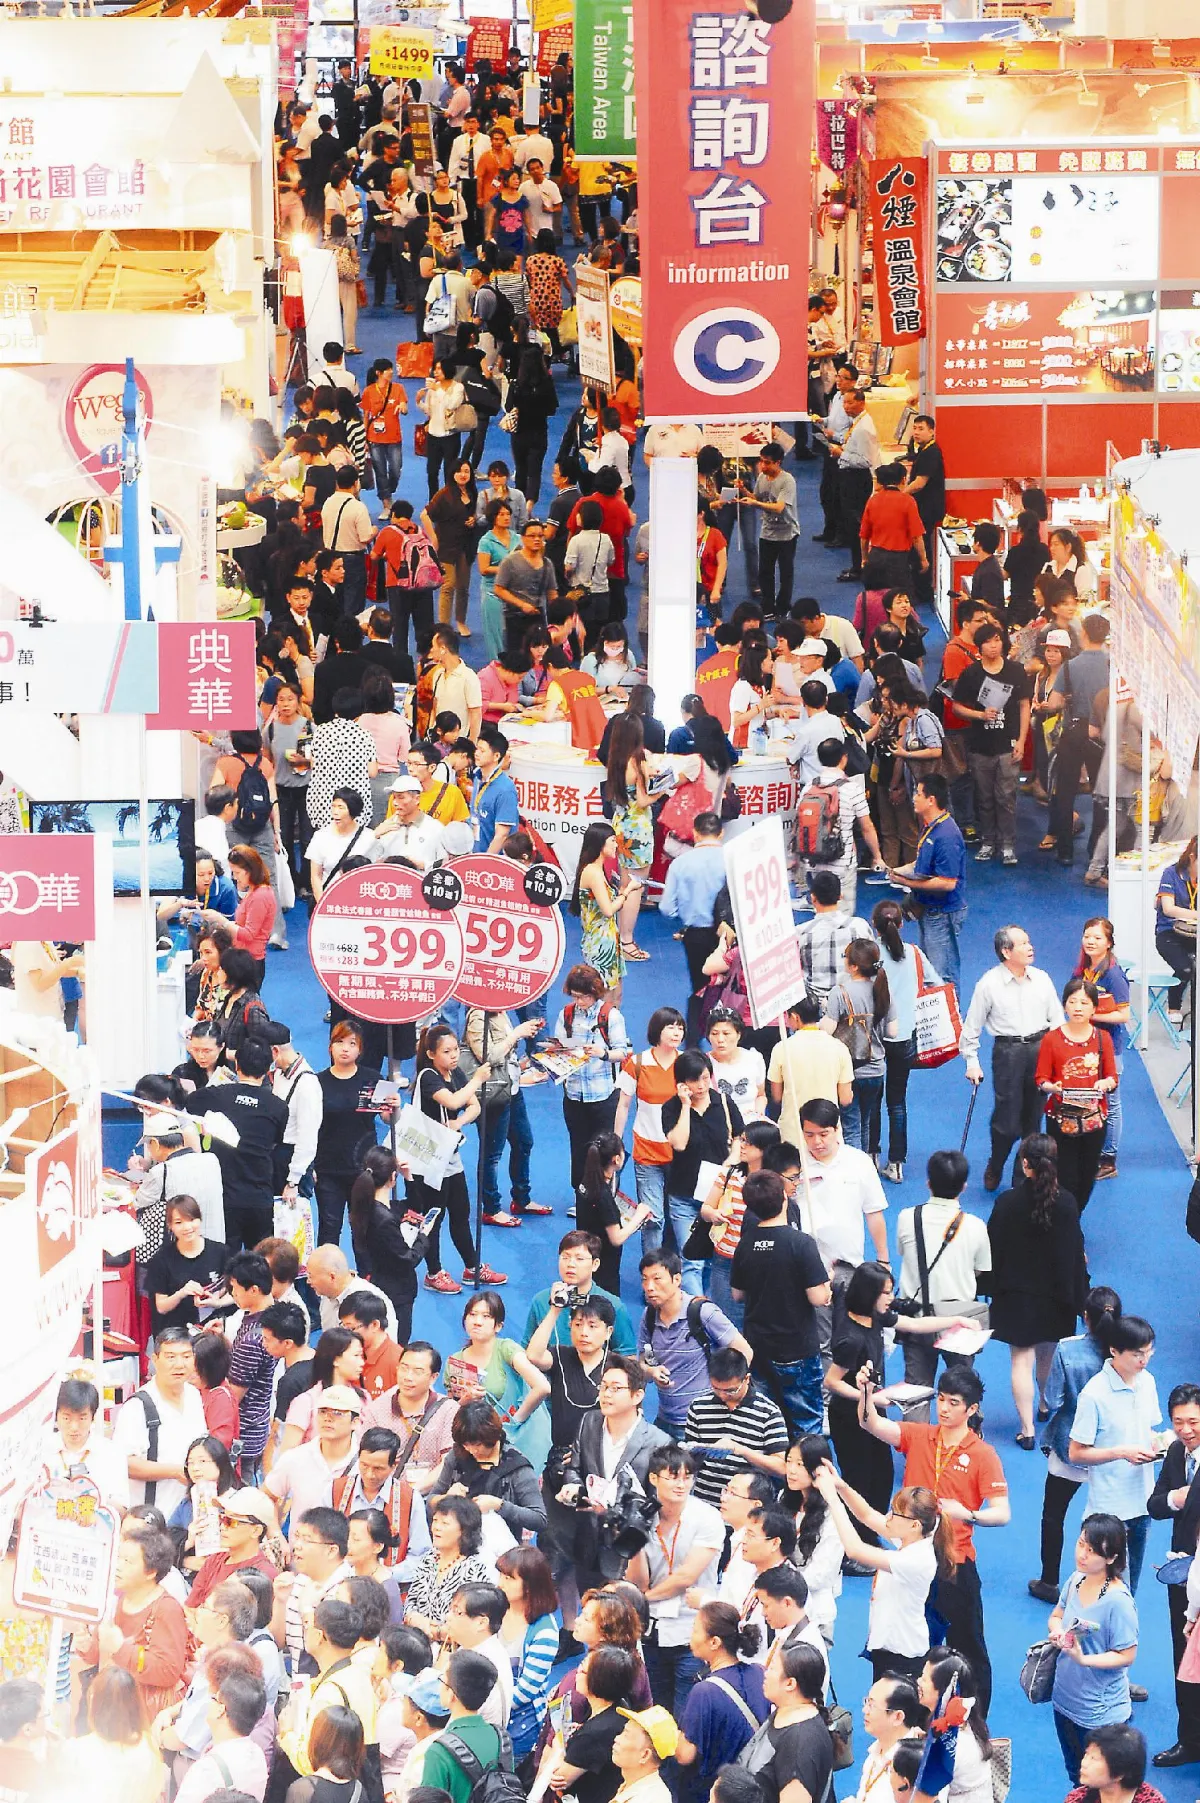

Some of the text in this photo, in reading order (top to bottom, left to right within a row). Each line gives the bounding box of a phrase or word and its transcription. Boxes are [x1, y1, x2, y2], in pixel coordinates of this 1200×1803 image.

[592, 20, 612, 140] Taiwan Area
[690, 14, 773, 246] 諮詢台
[667, 260, 790, 284] information
[885, 238, 922, 334] 溫泉會館
[693, 319, 766, 385] C
[74, 392, 130, 423] Weg
[187, 628, 233, 722] 典華
[561, 821, 591, 834] Des
[743, 855, 782, 926] 599
[363, 925, 446, 971] 399
[465, 912, 543, 963] 599
